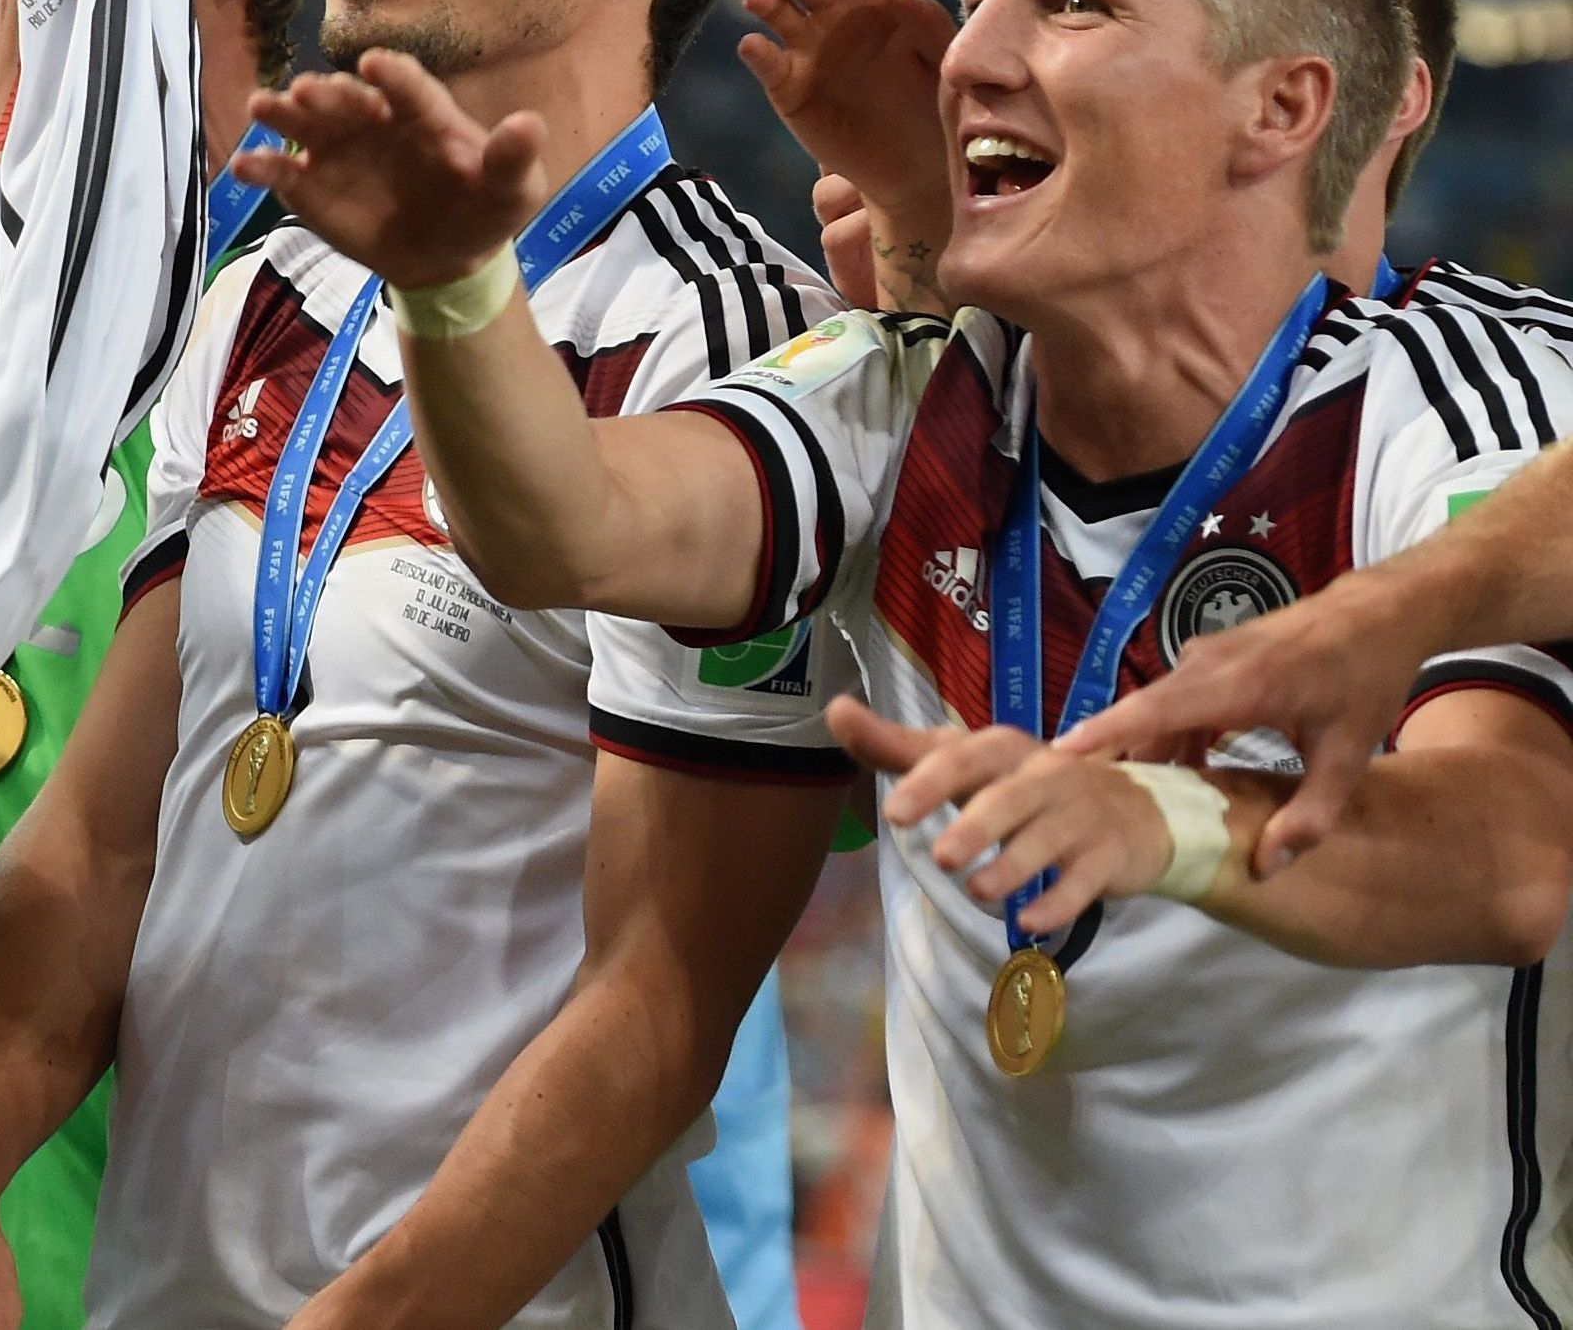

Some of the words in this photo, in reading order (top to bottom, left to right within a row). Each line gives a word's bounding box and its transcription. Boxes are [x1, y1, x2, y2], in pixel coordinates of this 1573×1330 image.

[28, 10, 47, 30] RIO
[547, 207, 585, 243] FIFA
[596, 161, 631, 195] FIFA
[638, 132, 663, 157] FIFA
[319, 355, 341, 392] FIFA
[294, 413, 317, 451] FIFA
[1206, 444, 1242, 482] FIFA
[276, 473, 295, 513] FIFA
[321, 513, 343, 552] FIFA
[1164, 505, 1198, 544] FIFA
[268, 540, 283, 581] FIFA
[296, 577, 314, 619] FIFA
[445, 579, 459, 596] VS
[923, 560, 990, 632] adidas
[1121, 566, 1155, 604] FIFA
[1184, 568, 1261, 603] DEUTSCHER
[402, 603, 419, 621] RIO
[417, 610, 432, 627] DE
[430, 616, 471, 643] JANEIRO
[426, 594, 449, 613] JULI
[447, 601, 471, 623] 2014
[262, 607, 275, 649] FIFA
[771, 679, 804, 694] FIFA
